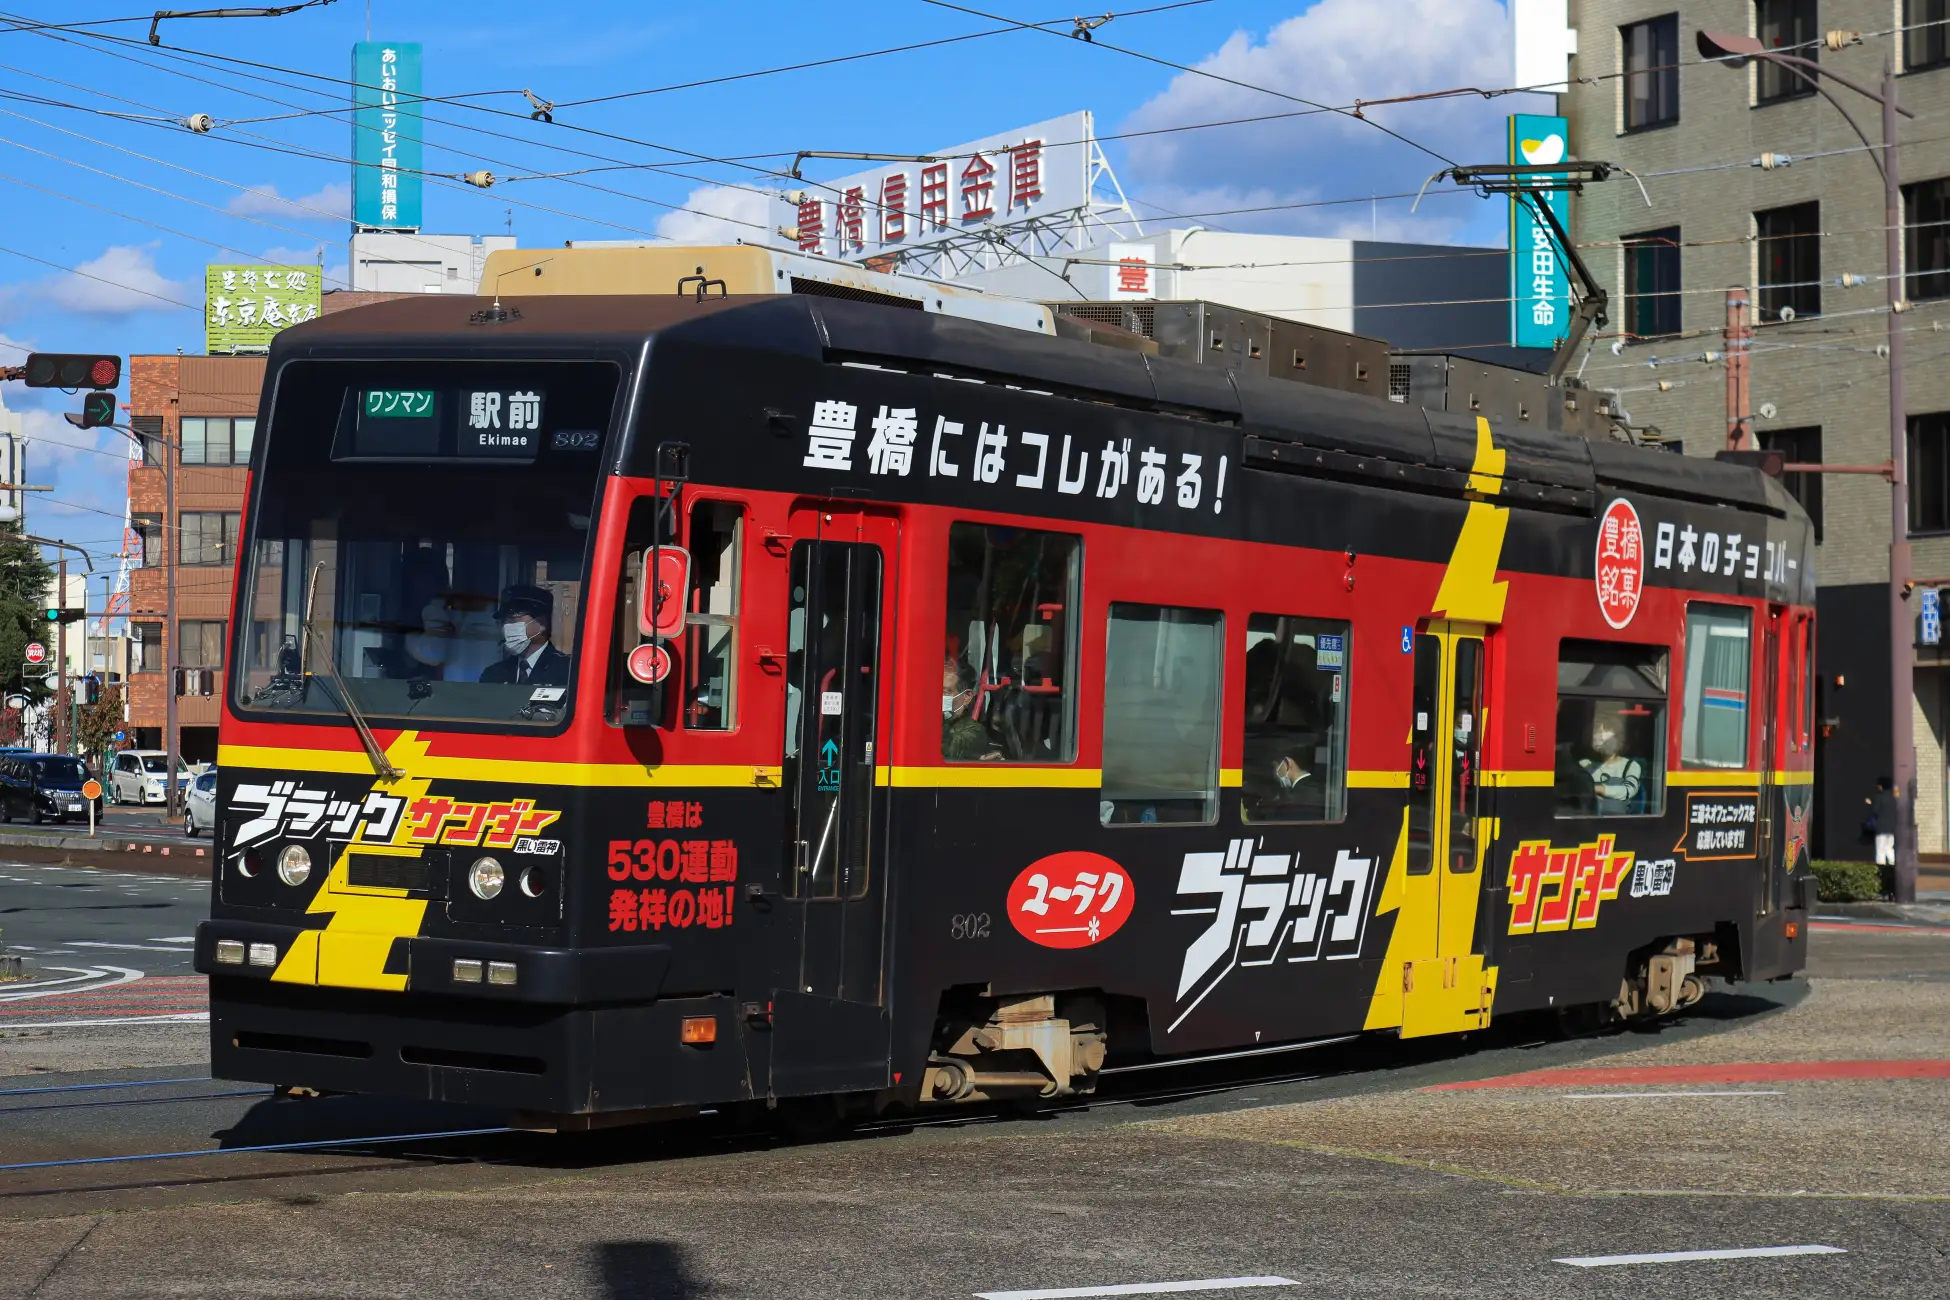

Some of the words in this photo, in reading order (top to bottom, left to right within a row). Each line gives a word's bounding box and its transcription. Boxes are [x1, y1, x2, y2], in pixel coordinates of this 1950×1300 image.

[381, 48, 397, 220] あいおいニッセイ同和損保
[799, 139, 1042, 255] 豊橋信用金庫
[1117, 256, 1148, 293] 豊
[369, 391, 431, 413] ワンマン
[469, 391, 541, 430] 駅前
[479, 434, 528, 446] Ekimae
[555, 432, 598, 447] 802
[803, 400, 1229, 515] 豊橋にはコレがある!
[1602, 516, 1640, 561] 豊橋
[1654, 521, 1797, 584] 日本のチョコバー
[1600, 565, 1638, 609] 銘菓
[819, 769, 840, 784] 入口
[647, 801, 703, 829] 豊橋は
[514, 838, 561, 855] 黒い雷神
[607, 839, 738, 883] 530運動
[1021, 871, 1124, 916] ユーラク
[1630, 859, 1676, 898] 黒い雷神
[608, 886, 735, 932] 発祥の地!
[950, 912, 991, 940] 802
[1168, 834, 1379, 1034] ブラック
[1507, 833, 1635, 935] サンダー
